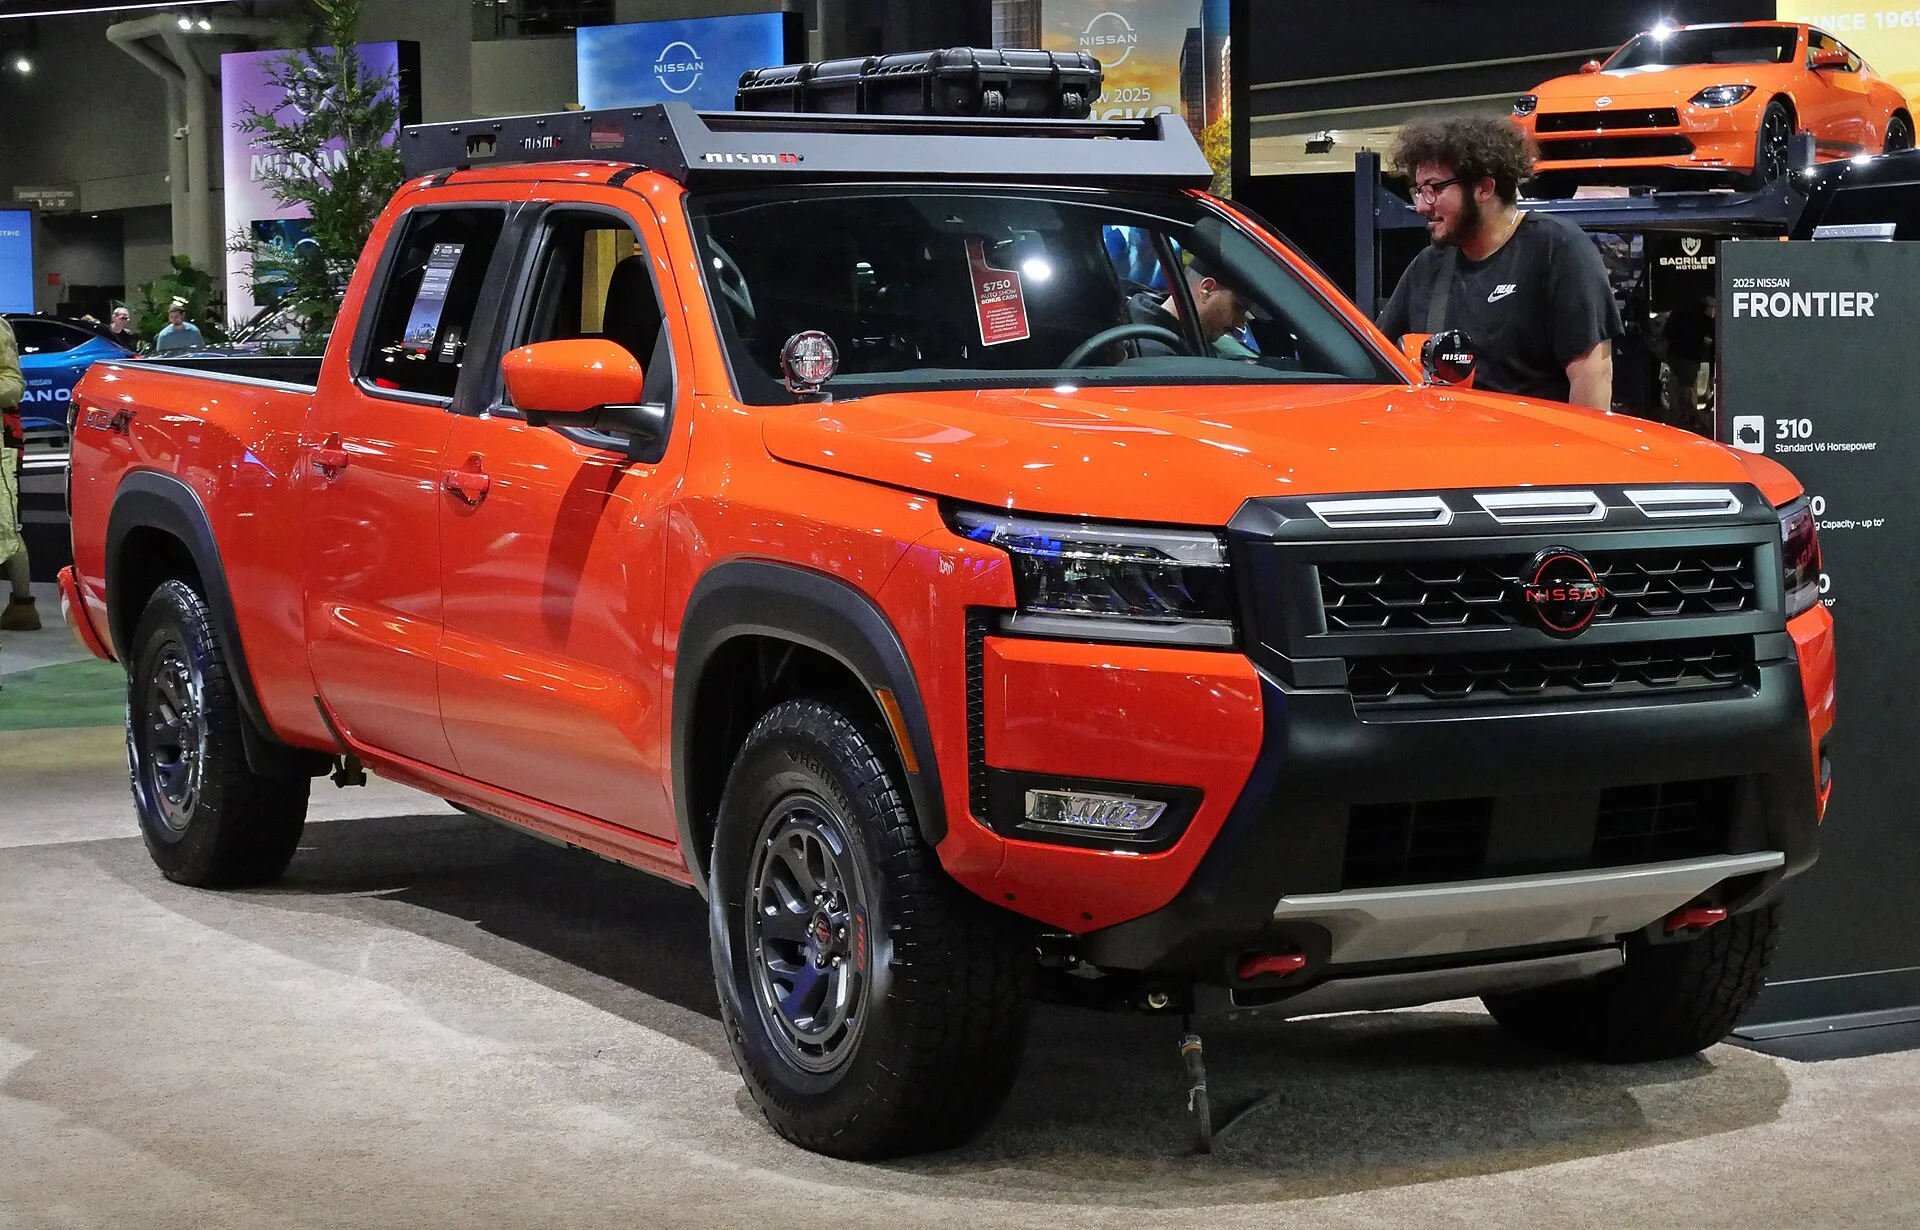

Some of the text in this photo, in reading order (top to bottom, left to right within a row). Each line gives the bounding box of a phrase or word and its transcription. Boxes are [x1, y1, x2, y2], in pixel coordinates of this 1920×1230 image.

[1080, 34, 1137, 46] NISSAN
[653, 61, 704, 73] NISSAN
[1114, 88, 1151, 103] 2025
[1659, 256, 1716, 266] SACRILEG
[983, 280, 1010, 292] $750
[1733, 278, 1790, 288] 2025 NISSAN
[981, 296, 1002, 305] BONUS
[20, 388, 71, 403] ANO
[1775, 418, 1813, 439] 310
[1775, 442, 1877, 453] Standard V6 Horsepower
[1821, 520, 1855, 531] Capacity
[1861, 520, 1873, 529] up
[1525, 586, 1606, 602] NISSAN
